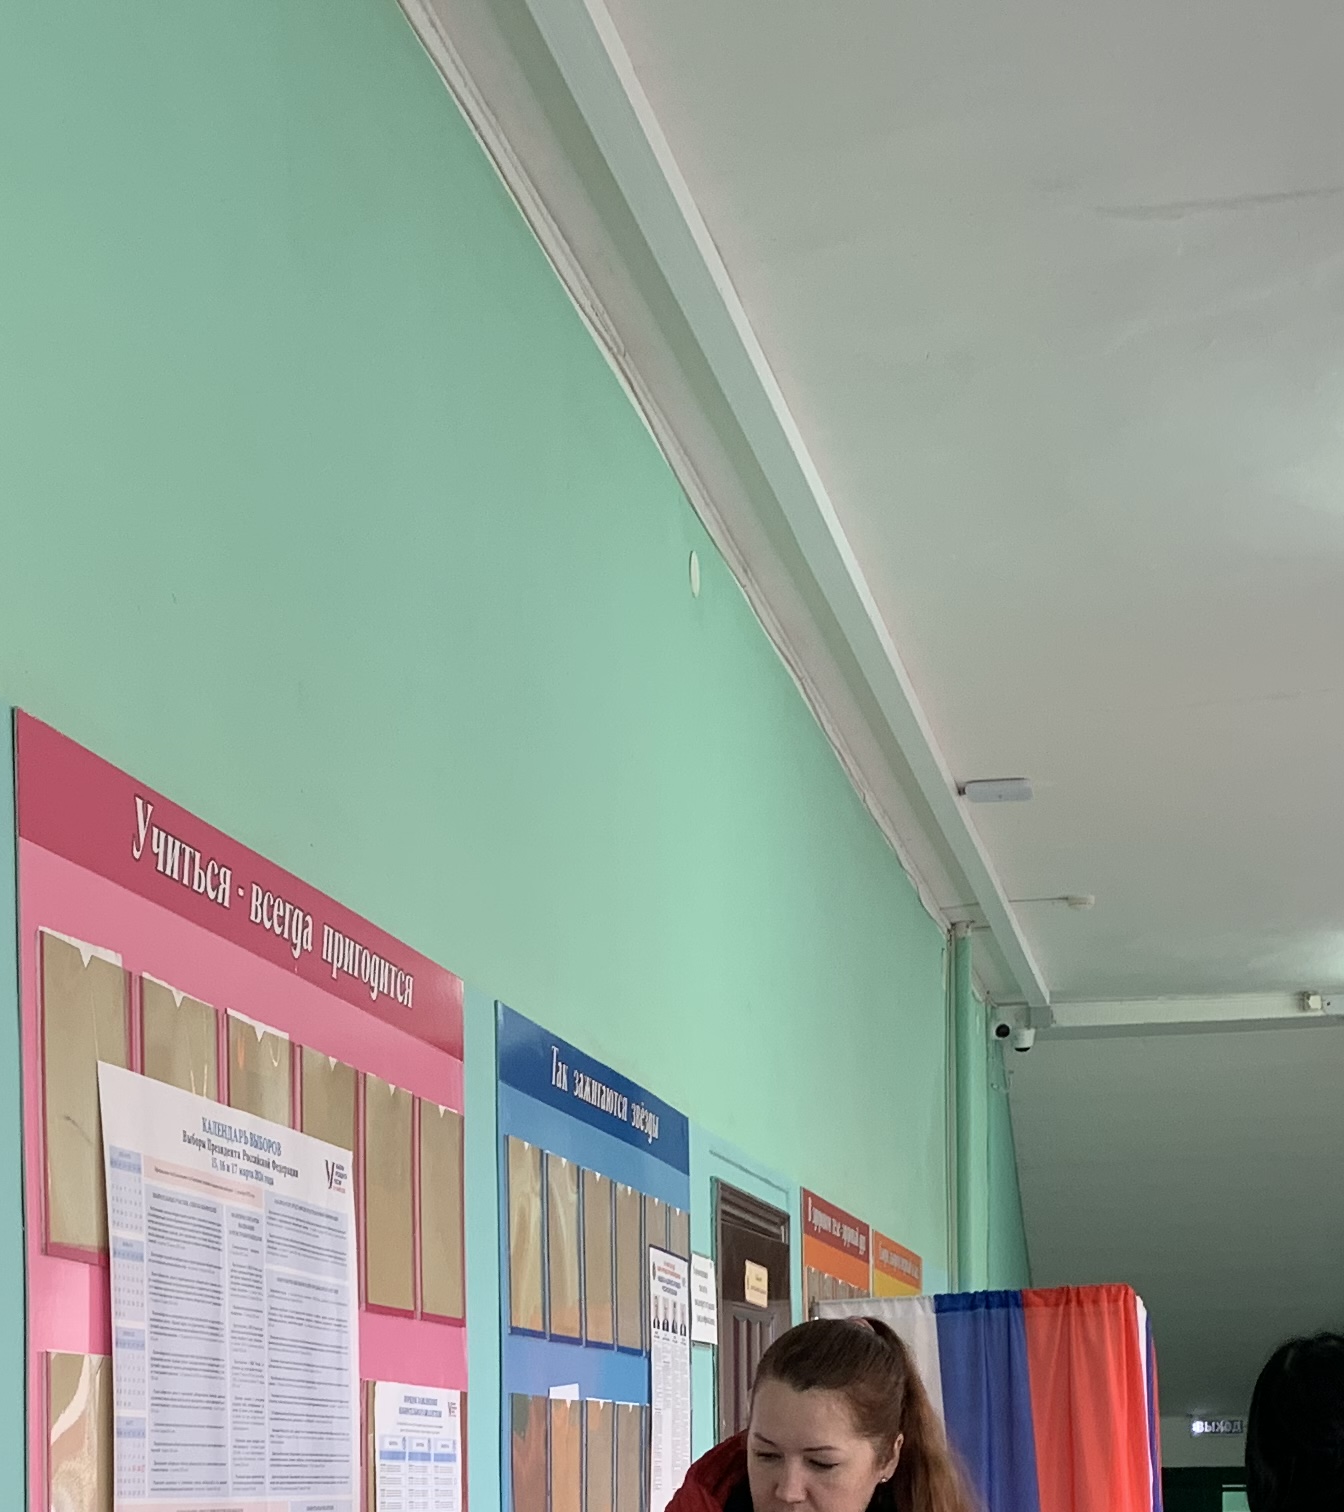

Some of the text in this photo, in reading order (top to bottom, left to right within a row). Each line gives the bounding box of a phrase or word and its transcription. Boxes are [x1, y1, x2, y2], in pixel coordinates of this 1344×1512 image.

[132, 793, 232, 909] Учиться
[249, 882, 314, 960] всегда
[322, 922, 414, 1010] пригодится
[551, 1045, 569, 1092] Так
[573, 1069, 628, 1122] зажигаются
[183, 1130, 206, 1150] Выборы
[207, 1138, 241, 1160] Президента
[202, 1117, 282, 1156] КАЛЕНДАРЬ ВЫБОРОВ
[1194, 1420, 1242, 1433] ВЫХОД
